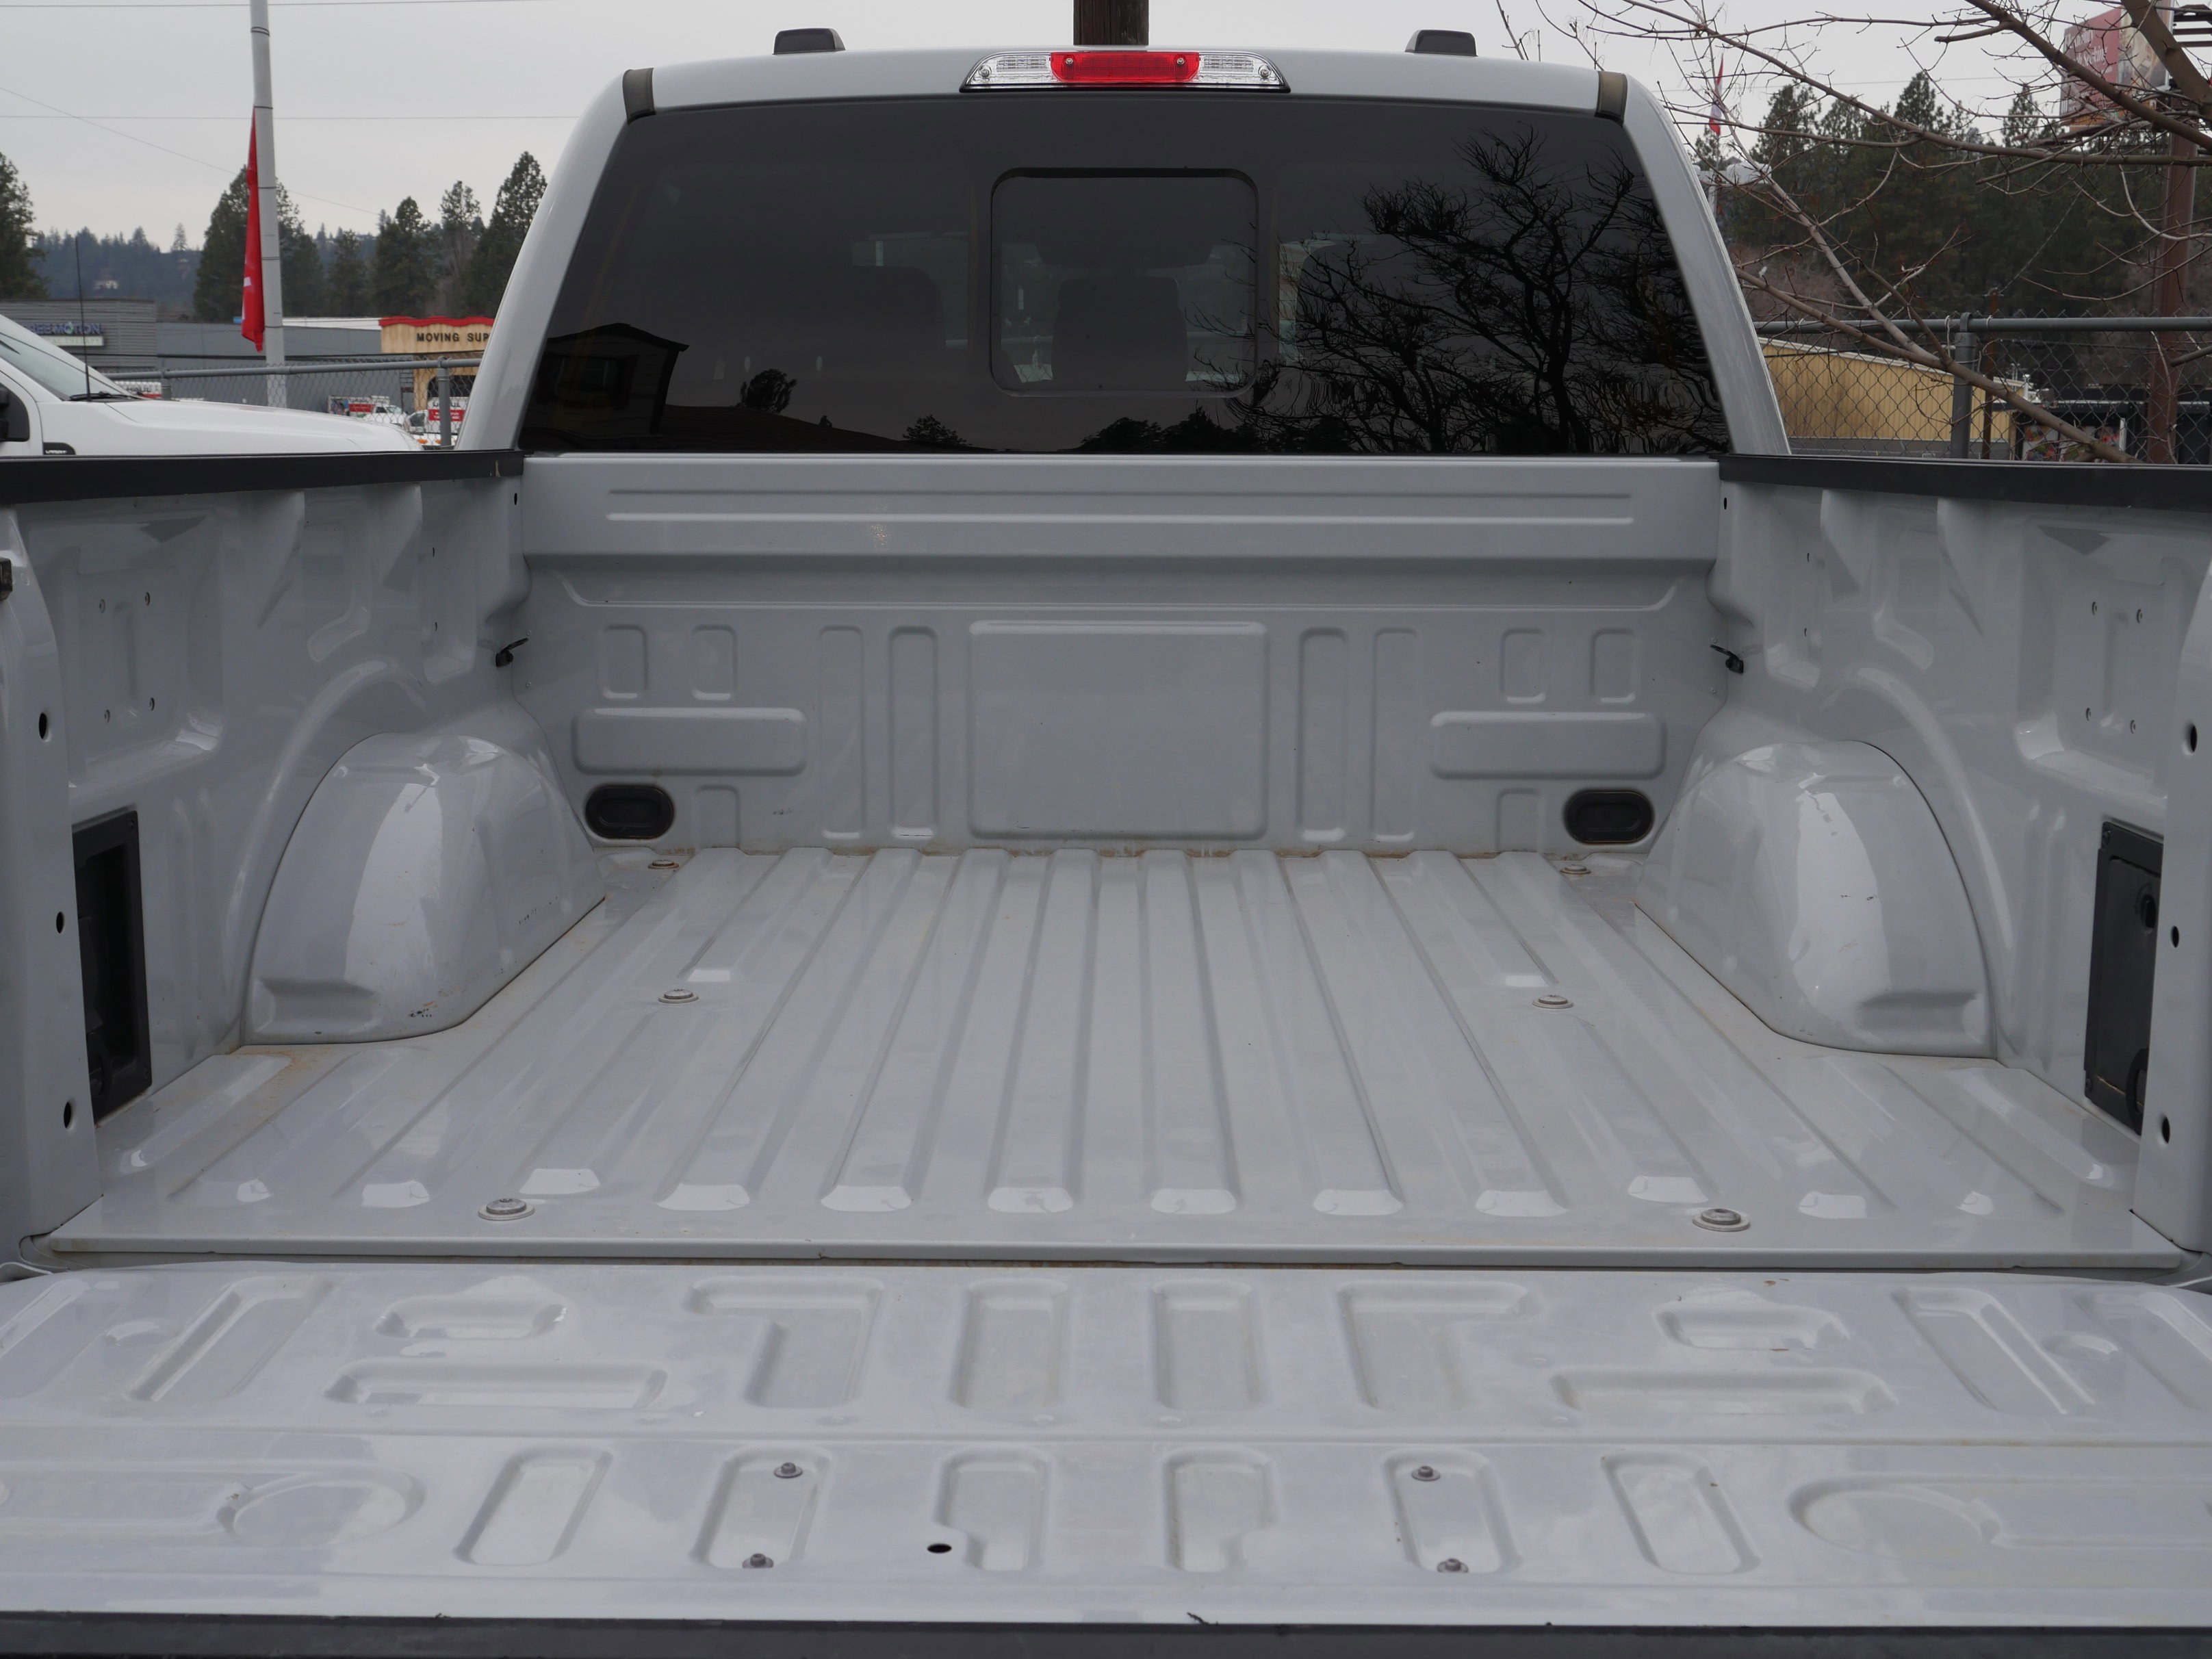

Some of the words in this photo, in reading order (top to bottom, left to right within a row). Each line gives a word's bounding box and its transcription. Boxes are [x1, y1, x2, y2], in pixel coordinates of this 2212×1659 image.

[55, 321, 101, 334] MOTION
[417, 333, 459, 342] MOVING
[467, 333, 489, 342] SUP
